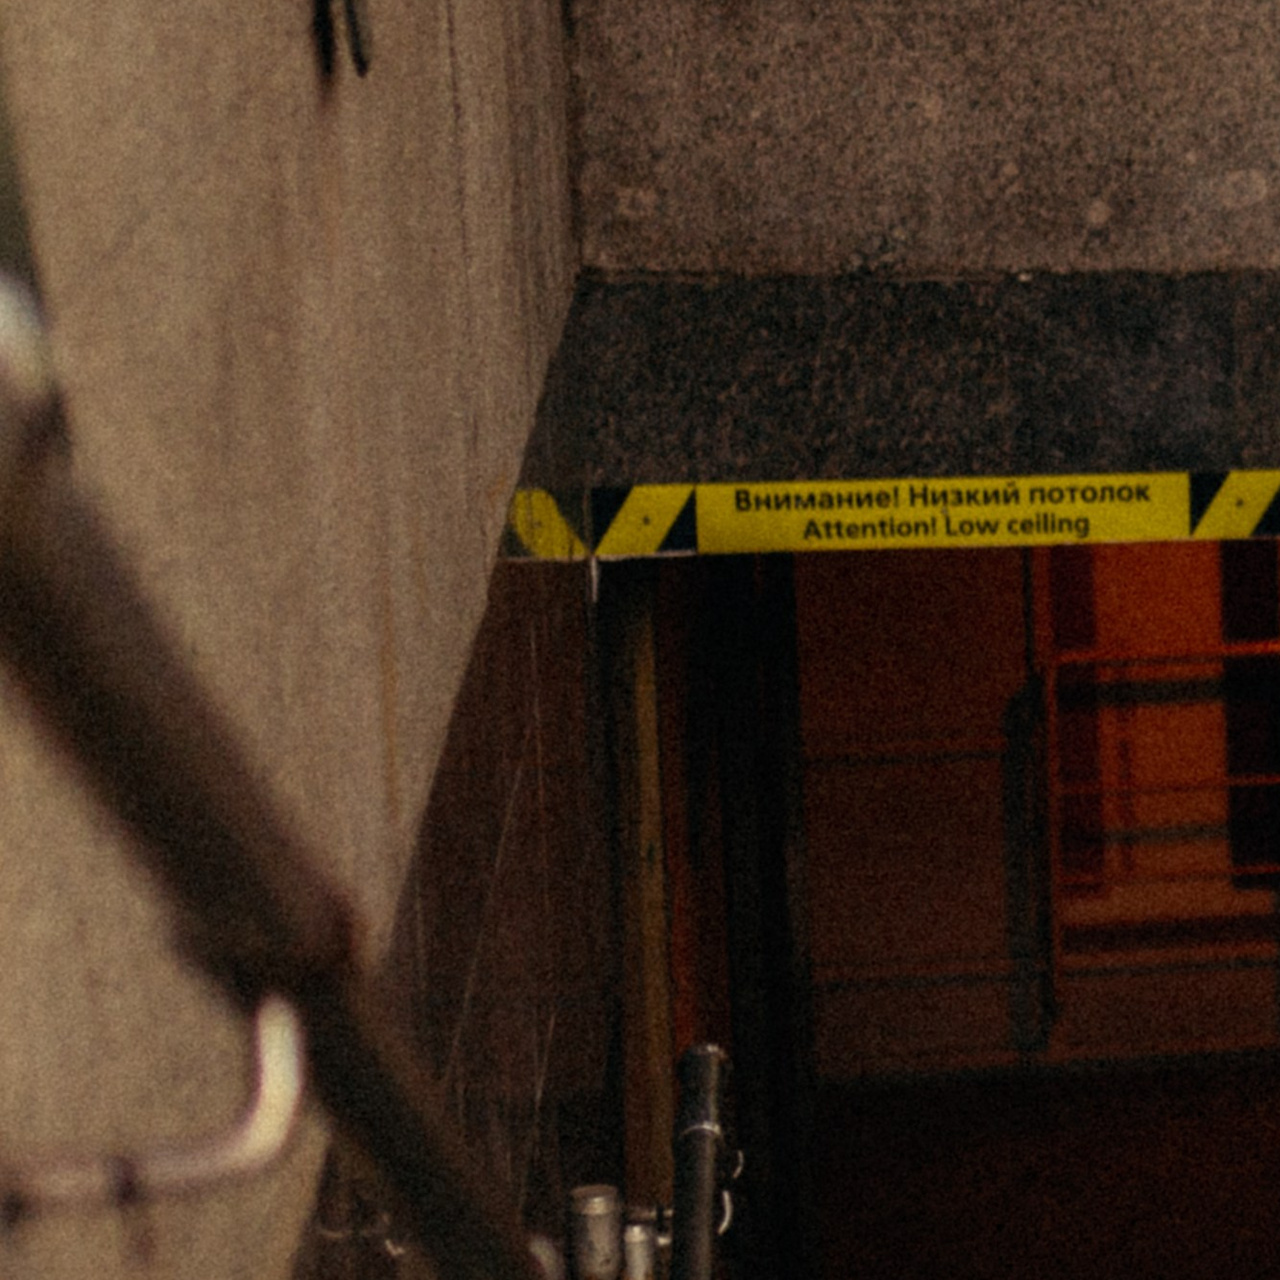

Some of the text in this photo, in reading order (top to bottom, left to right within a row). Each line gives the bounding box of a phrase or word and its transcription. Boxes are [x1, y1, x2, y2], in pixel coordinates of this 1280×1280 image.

[734, 481, 1150, 512] Внимание! Низкий потолок
[803, 511, 1090, 541] Attention! Low ceiling
